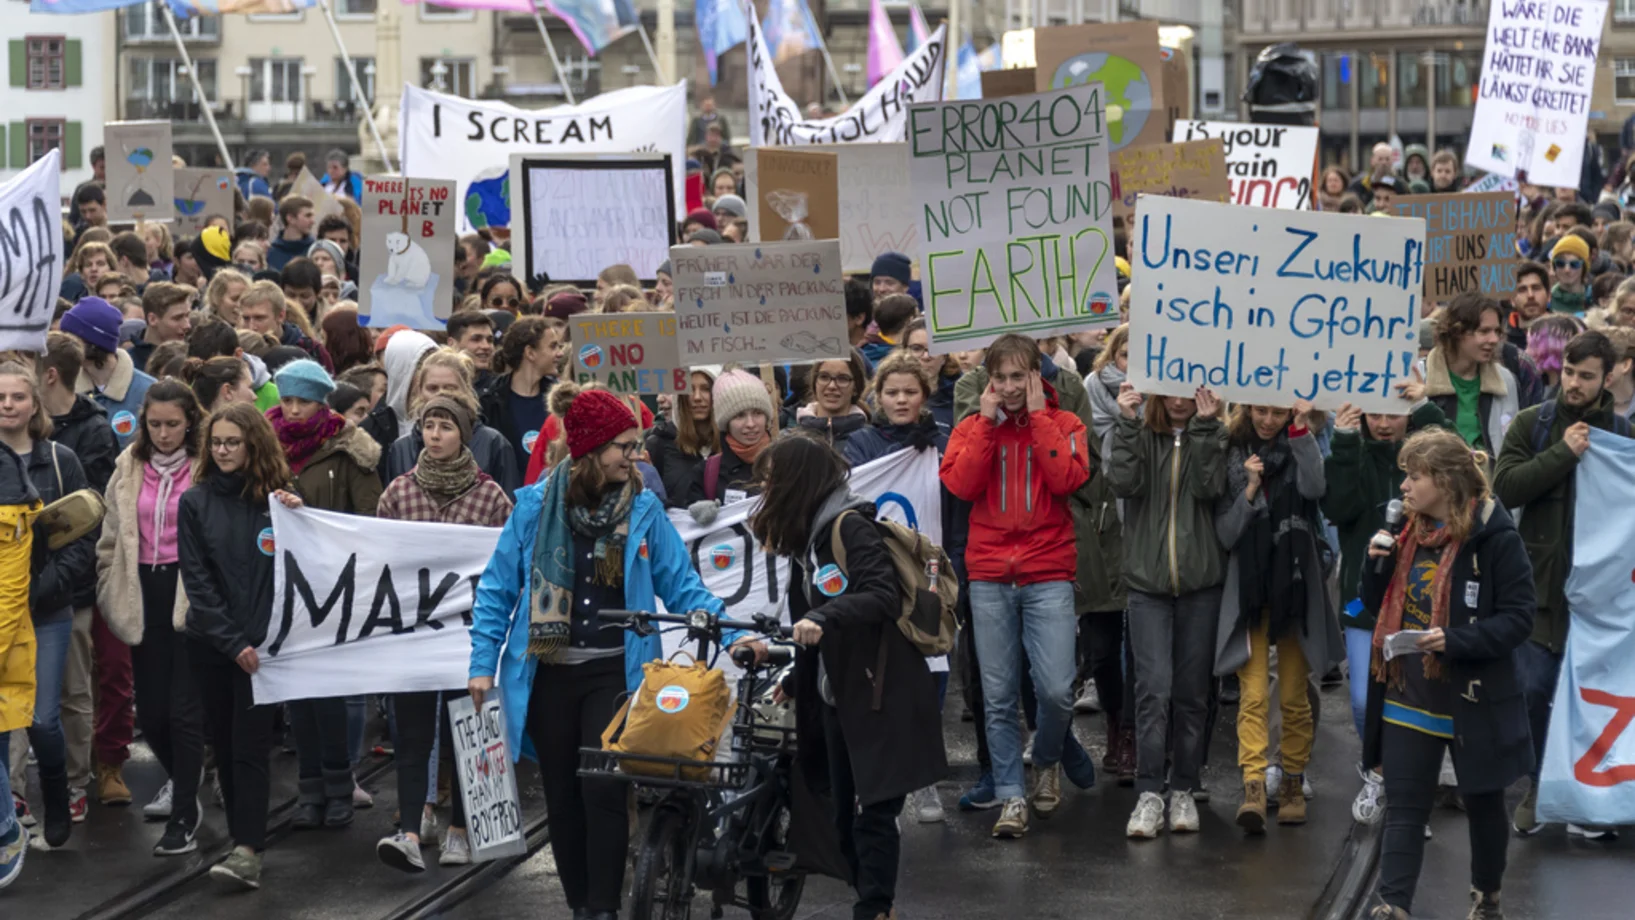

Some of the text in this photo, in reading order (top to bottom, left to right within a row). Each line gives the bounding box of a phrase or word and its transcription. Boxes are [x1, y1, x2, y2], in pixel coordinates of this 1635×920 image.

[1554, 5, 1583, 27] DIE
[1493, 27, 1529, 49] WELT
[1563, 34, 1597, 62] BANK
[1490, 47, 1534, 77] HÄTTET
[1558, 62, 1586, 87] SIE
[1481, 75, 1531, 103] LÄNGST
[433, 103, 614, 145] I SCREAM
[1221, 127, 1287, 155] your
[946, 143, 1099, 189] PLANET
[1227, 153, 1277, 177] rain
[365, 180, 449, 201] THERE IS NO
[378, 199, 444, 216] PLANET
[924, 191, 989, 242] NOT
[1007, 180, 1112, 235] FOUND
[421, 219, 435, 238] B
[1141, 214, 1259, 277] Unseri
[1277, 226, 1424, 290] Zuekunft
[1455, 233, 1486, 261] UNS
[1486, 232, 1516, 260] AUS
[676, 256, 740, 275] FRÜHER
[745, 252, 785, 271] WAR
[790, 252, 822, 269] DER
[678, 285, 721, 304] FISCH
[728, 284, 743, 300] IN
[744, 282, 774, 299] DER
[1434, 266, 1479, 296] HAUS
[1480, 263, 1517, 293] RAUS
[577, 317, 677, 340] THERE IS
[679, 305, 843, 330] HEUTE IST DIE PACKUNG
[1156, 283, 1416, 349] isch in Gfohr!
[609, 342, 645, 367] NO
[687, 338, 704, 354] IM
[672, 367, 687, 391] B
[1145, 334, 1414, 401] Handlet jetzt!
[455, 714, 477, 751] THE
[464, 756, 475, 786] IS
[466, 780, 492, 815] THAN
